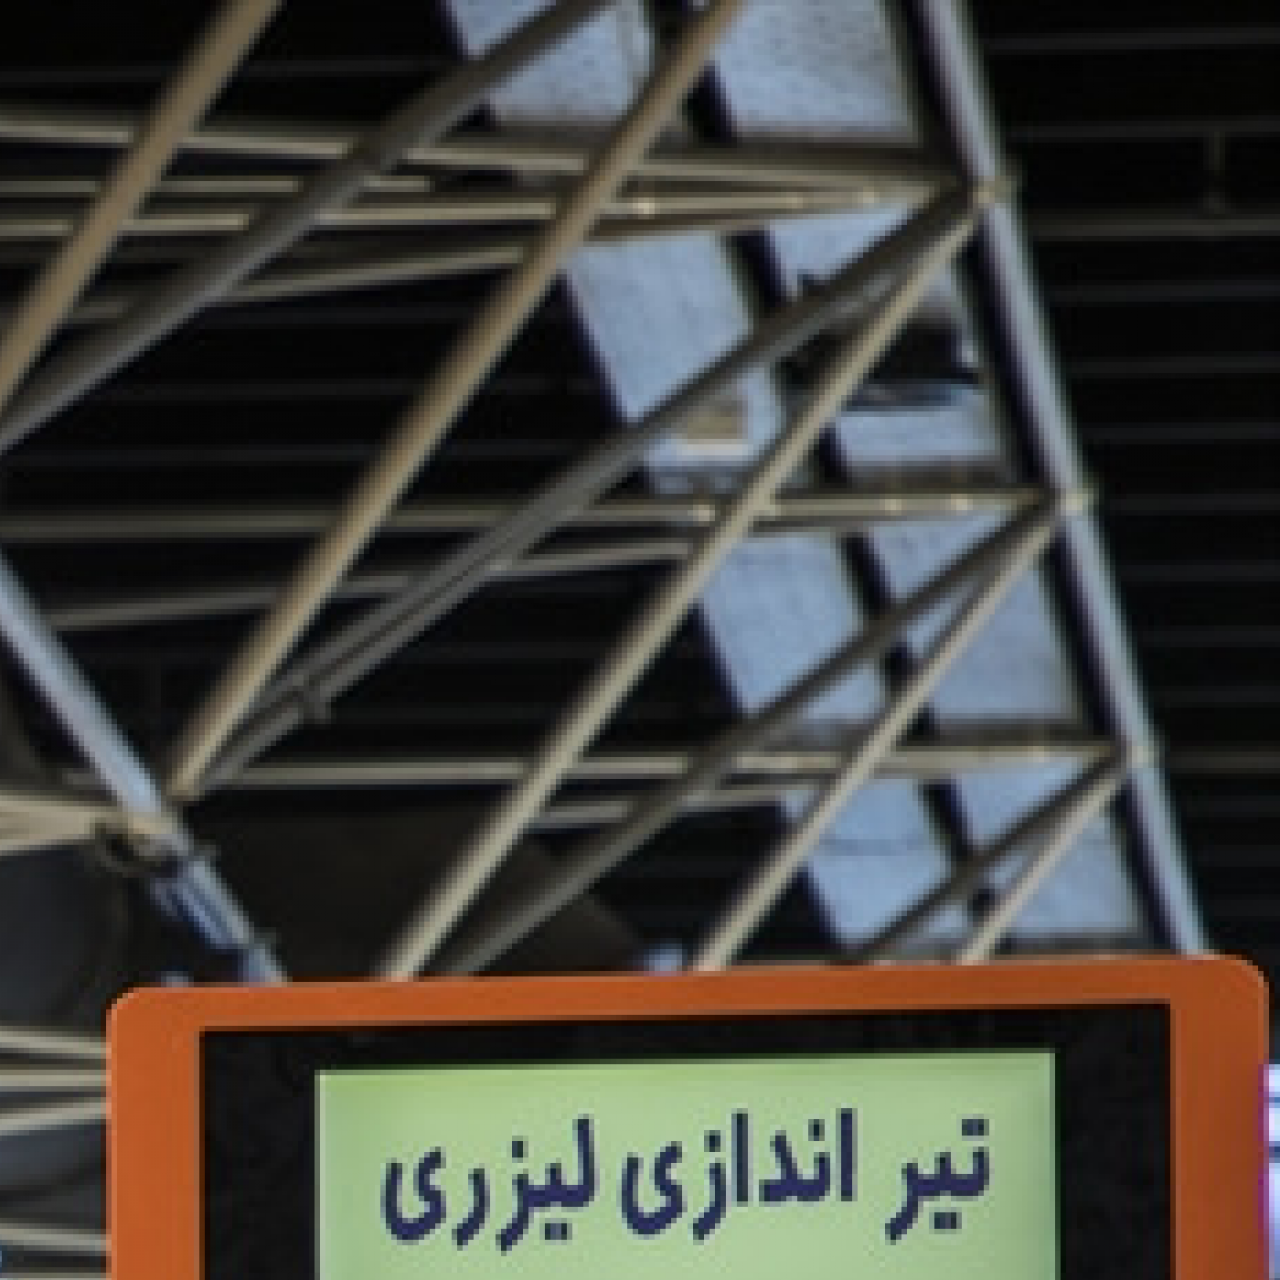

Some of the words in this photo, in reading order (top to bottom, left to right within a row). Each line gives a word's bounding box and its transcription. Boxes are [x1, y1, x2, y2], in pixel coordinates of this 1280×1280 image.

[380, 1112, 599, 1255] لیزری
[619, 1106, 859, 1245] اندازی
[884, 1114, 991, 1245] تیر
